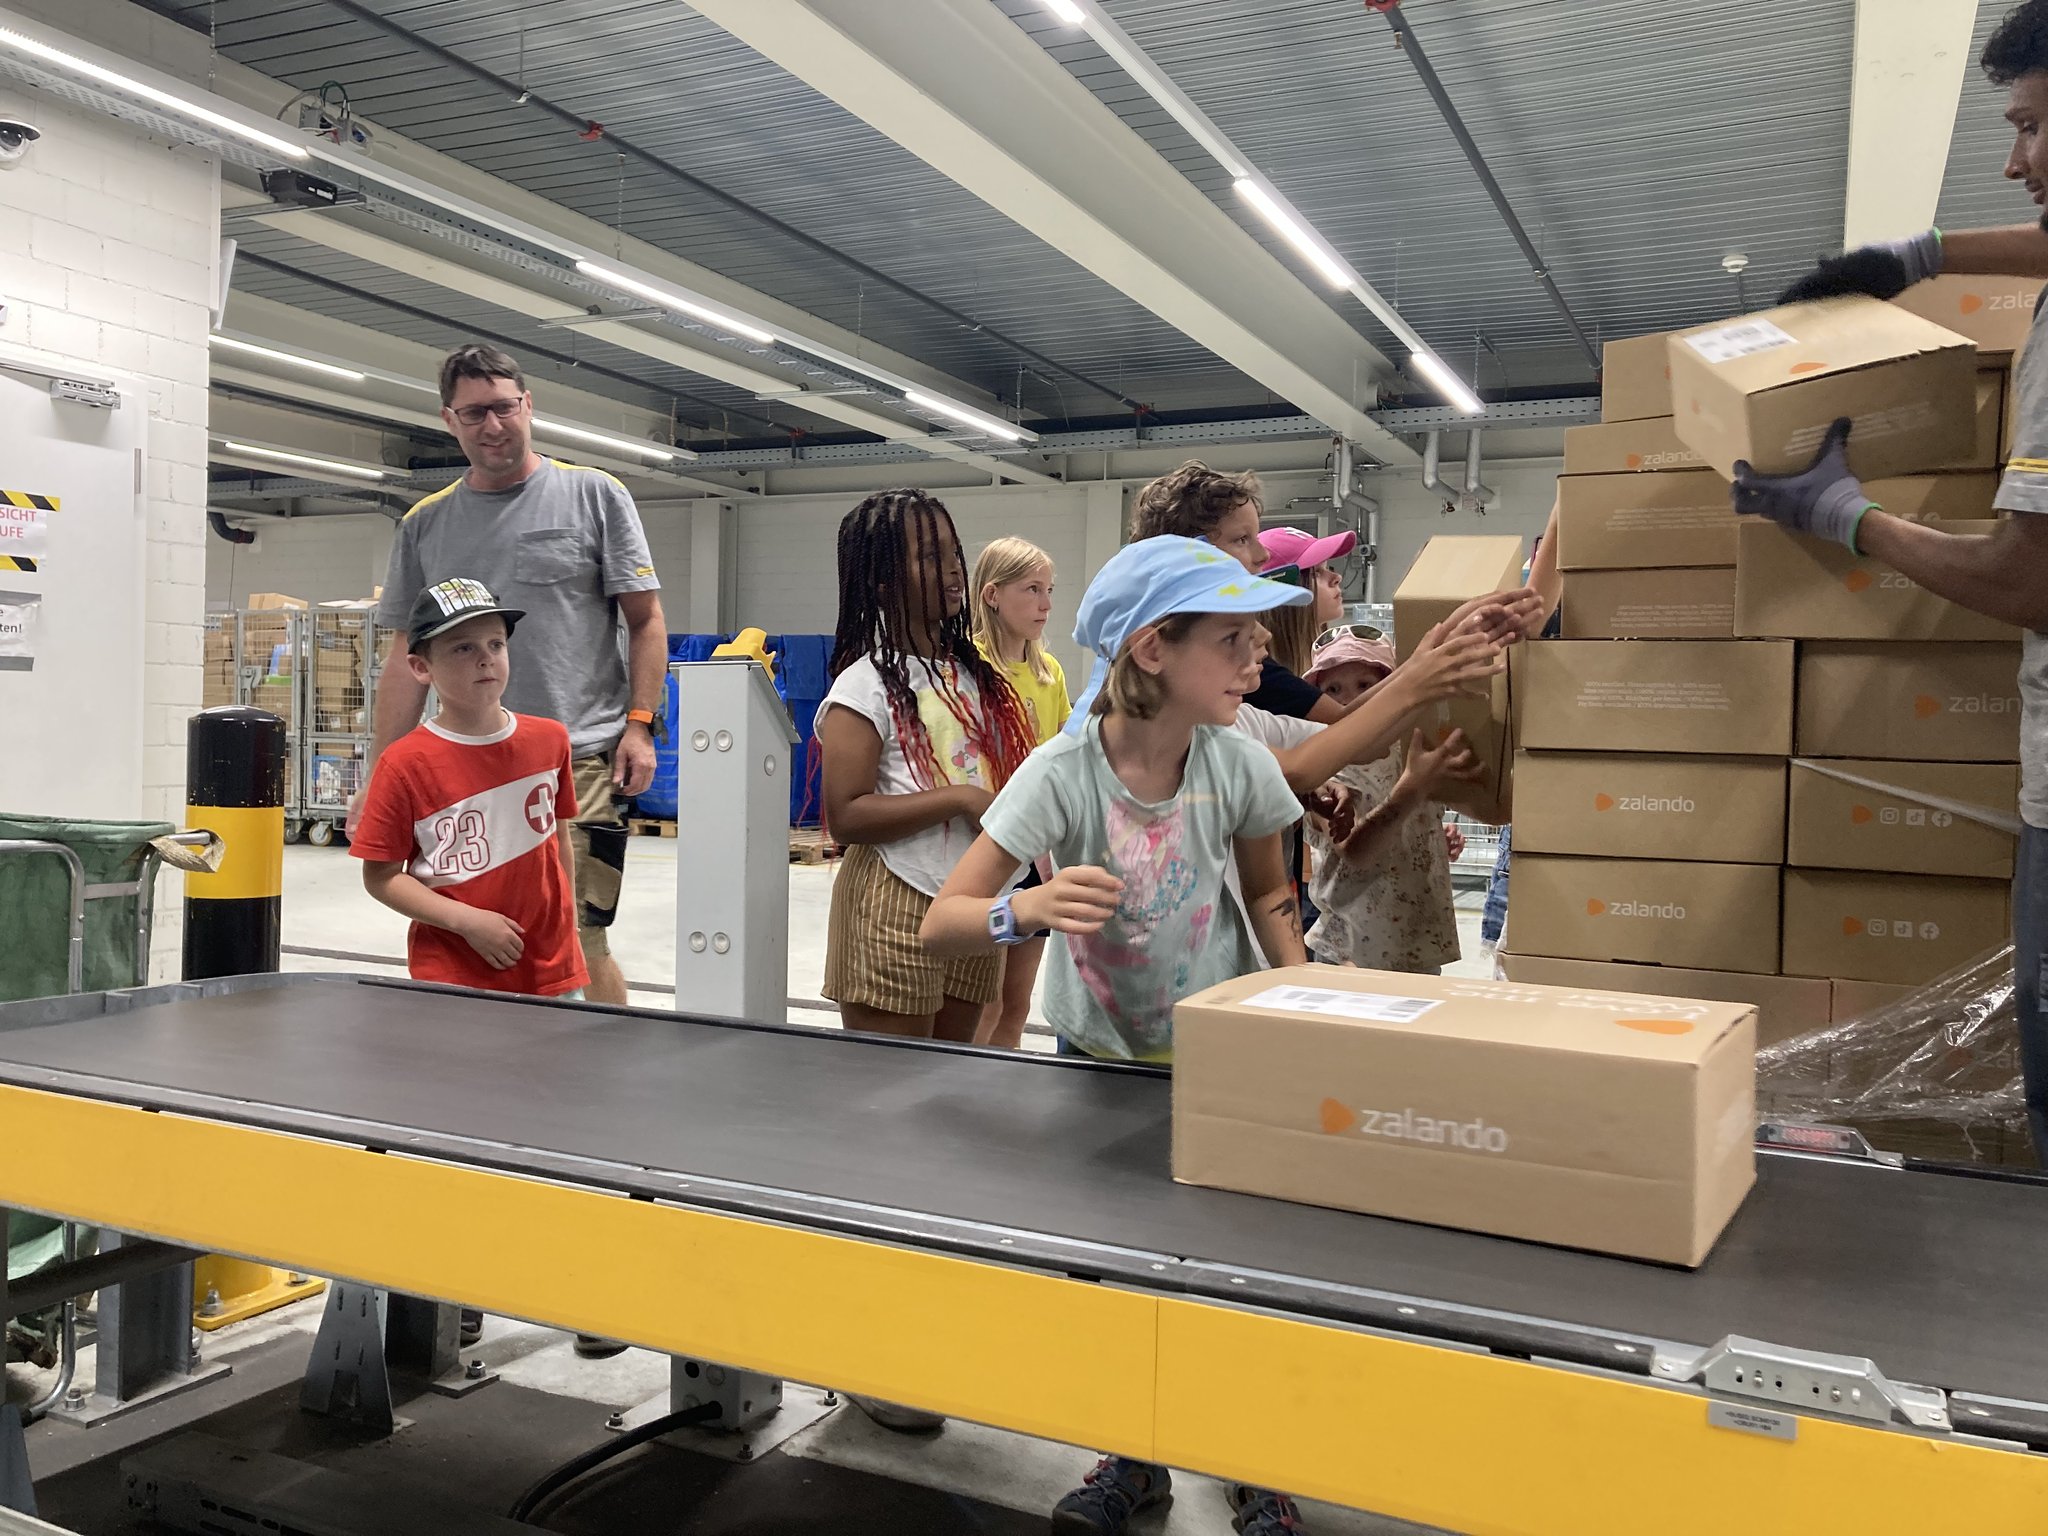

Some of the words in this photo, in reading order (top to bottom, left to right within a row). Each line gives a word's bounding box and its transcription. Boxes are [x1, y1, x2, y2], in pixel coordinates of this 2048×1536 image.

[1988, 290, 2037, 311] zala
[1948, 692, 2022, 713] zalan
[1618, 794, 1695, 813] zalando
[433, 810, 491, 877] 23
[1610, 900, 1686, 919] zalando
[1360, 1107, 1509, 1153] zalando
